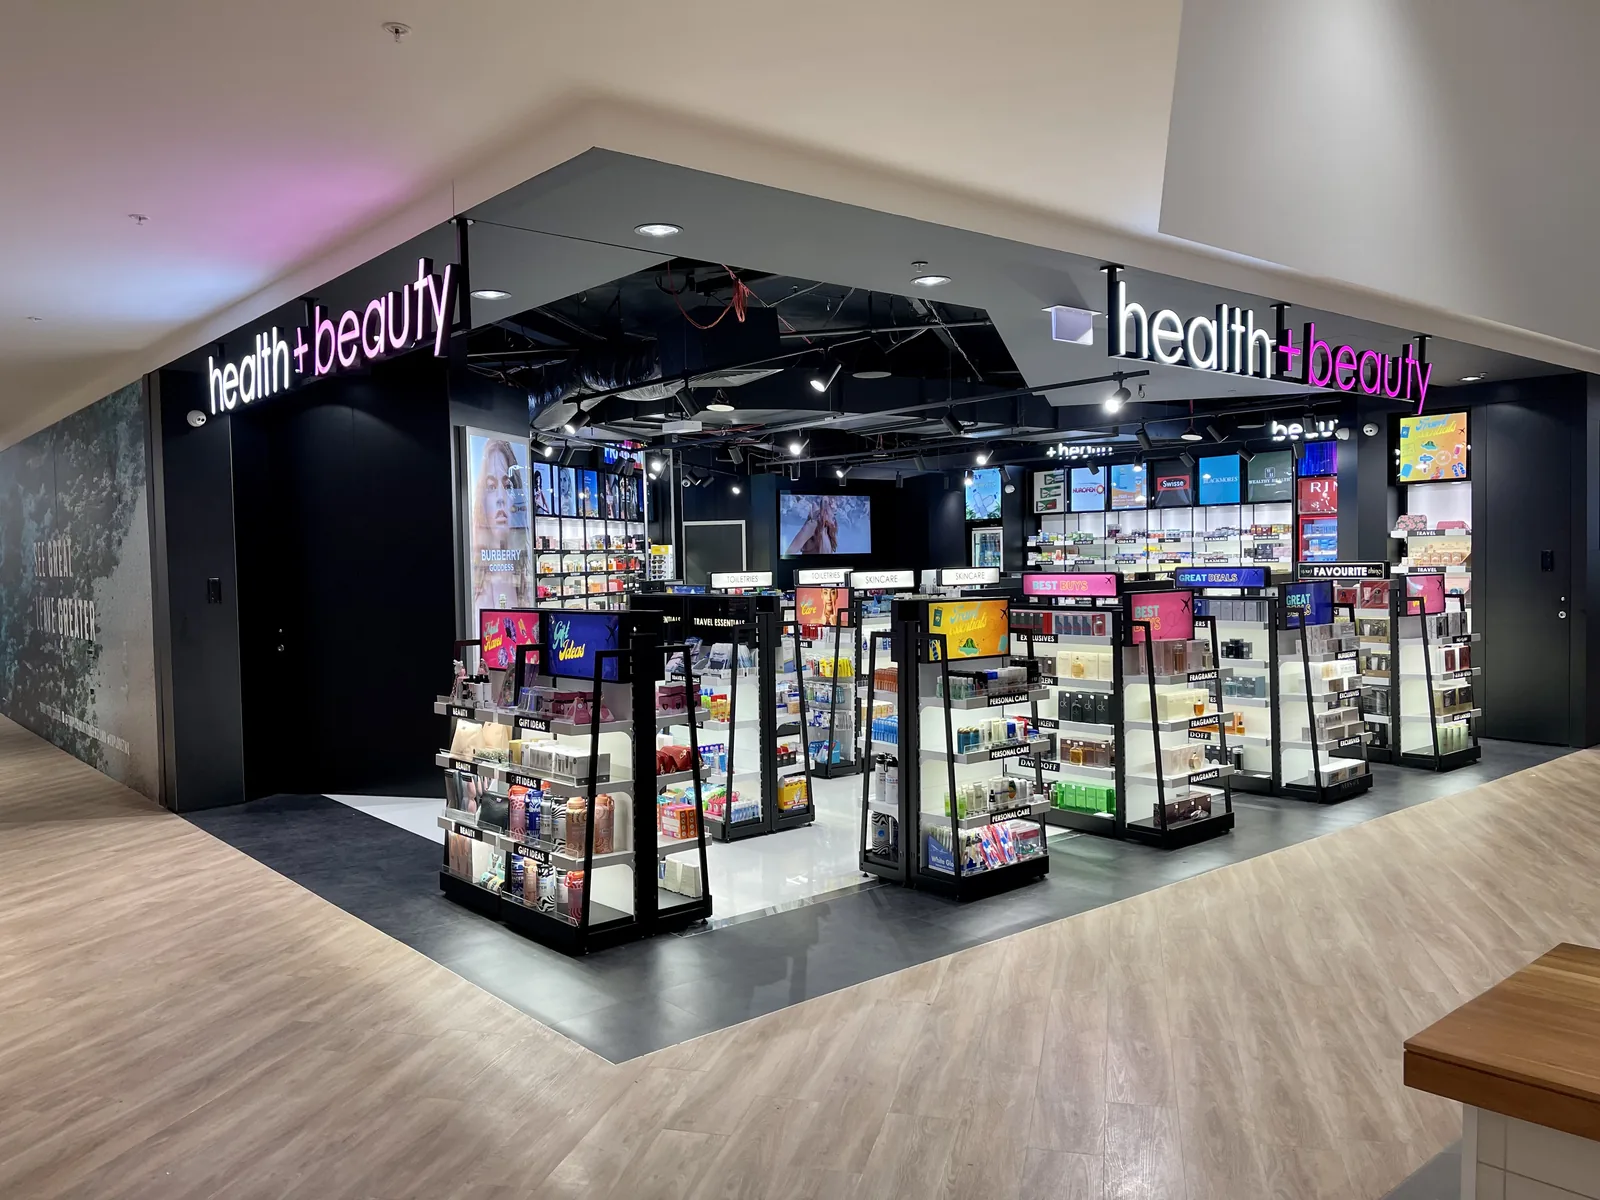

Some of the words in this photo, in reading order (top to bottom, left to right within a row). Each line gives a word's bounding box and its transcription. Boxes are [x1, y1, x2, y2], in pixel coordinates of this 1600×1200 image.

[1162, 479, 1184, 488] Swisse
[48, 538, 73, 578] GREAT
[482, 550, 521, 561] BURBERRY
[489, 564, 514, 572] GODDESS
[1314, 565, 1368, 576] FAVOURITE
[726, 575, 758, 584] TOILETRIES
[812, 572, 840, 580] TOILETRIES
[865, 574, 898, 584] SKINCARE
[956, 572, 985, 580] SKINCARE
[1179, 574, 1207, 582] GREAT
[1208, 574, 1238, 582] DEALS
[1032, 581, 1058, 590] BEST
[1060, 581, 1088, 591] BUYS
[1286, 593, 1310, 606] GREAT
[950, 601, 981, 624] Travel
[1134, 605, 1160, 619] BEST
[58, 597, 96, 641] GREATER
[694, 617, 714, 627] TRAVEL
[552, 620, 570, 649] Gift
[1020, 634, 1055, 642] EXLUSIVES
[558, 639, 586, 662] Ideas
[1189, 671, 1218, 682] FRAGRANCE
[990, 695, 1014, 706] PERSONAL
[1014, 694, 1028, 702] CARE
[452, 708, 468, 718] BEAUTY
[518, 718, 530, 727] GIFT
[530, 720, 546, 730] IDEAS
[1191, 716, 1218, 727] FRAGRANCE
[992, 748, 1016, 759] PERSONAL
[1016, 746, 1030, 754] CARE
[456, 761, 471, 772] BEAUTY
[522, 776, 537, 788] IDEAS
[1190, 770, 1218, 783] FRAGRANCE
[992, 811, 1016, 823] PERSONAL
[1016, 807, 1030, 816] CARE
[460, 826, 476, 838] BEAUTY
[518, 846, 530, 857] GIFT
[530, 848, 545, 862] IDEAS
[931, 856, 944, 865] White
